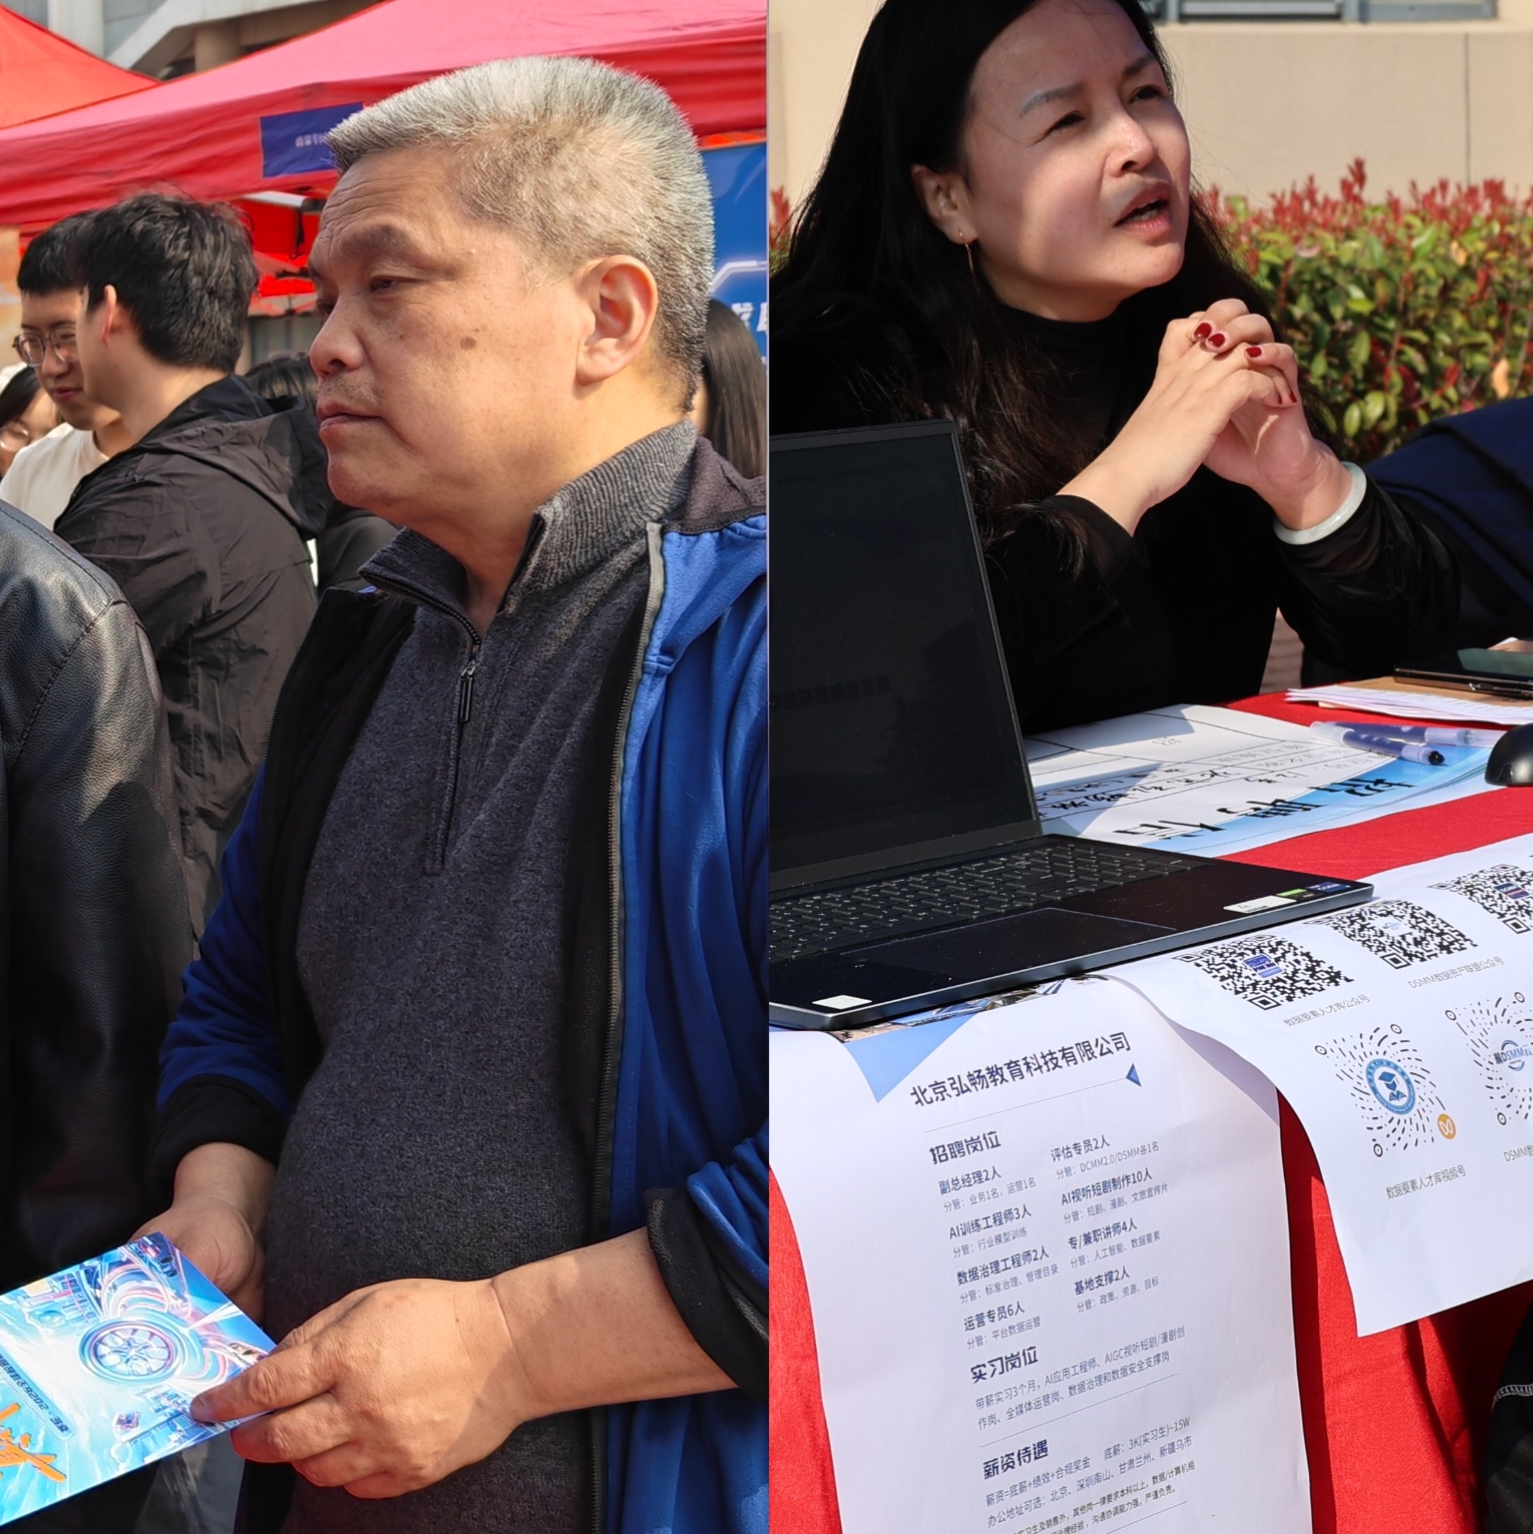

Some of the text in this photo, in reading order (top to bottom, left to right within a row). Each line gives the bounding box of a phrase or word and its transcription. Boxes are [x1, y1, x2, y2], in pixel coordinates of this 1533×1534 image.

[910, 1030, 1133, 1107] 北京弘畅教育科技有限公司
[928, 1129, 1002, 1166] 招聘岗位
[1049, 1134, 1111, 1163] 评估专员2人
[937, 1165, 1002, 1196] 副总经理2人
[1060, 1166, 1153, 1207] AI视听短剧制作10人
[948, 1203, 1032, 1240] AI训练工程师3人
[1067, 1217, 1138, 1251] 专/兼职讲师4人
[956, 1245, 1050, 1287] 数据治理工程师2人
[1073, 1265, 1131, 1297] 基地支撑2人
[963, 1300, 1026, 1333] 运营专员6人
[969, 1344, 1039, 1385] 实习岗位
[982, 1438, 1050, 1481] 薪资待遇
